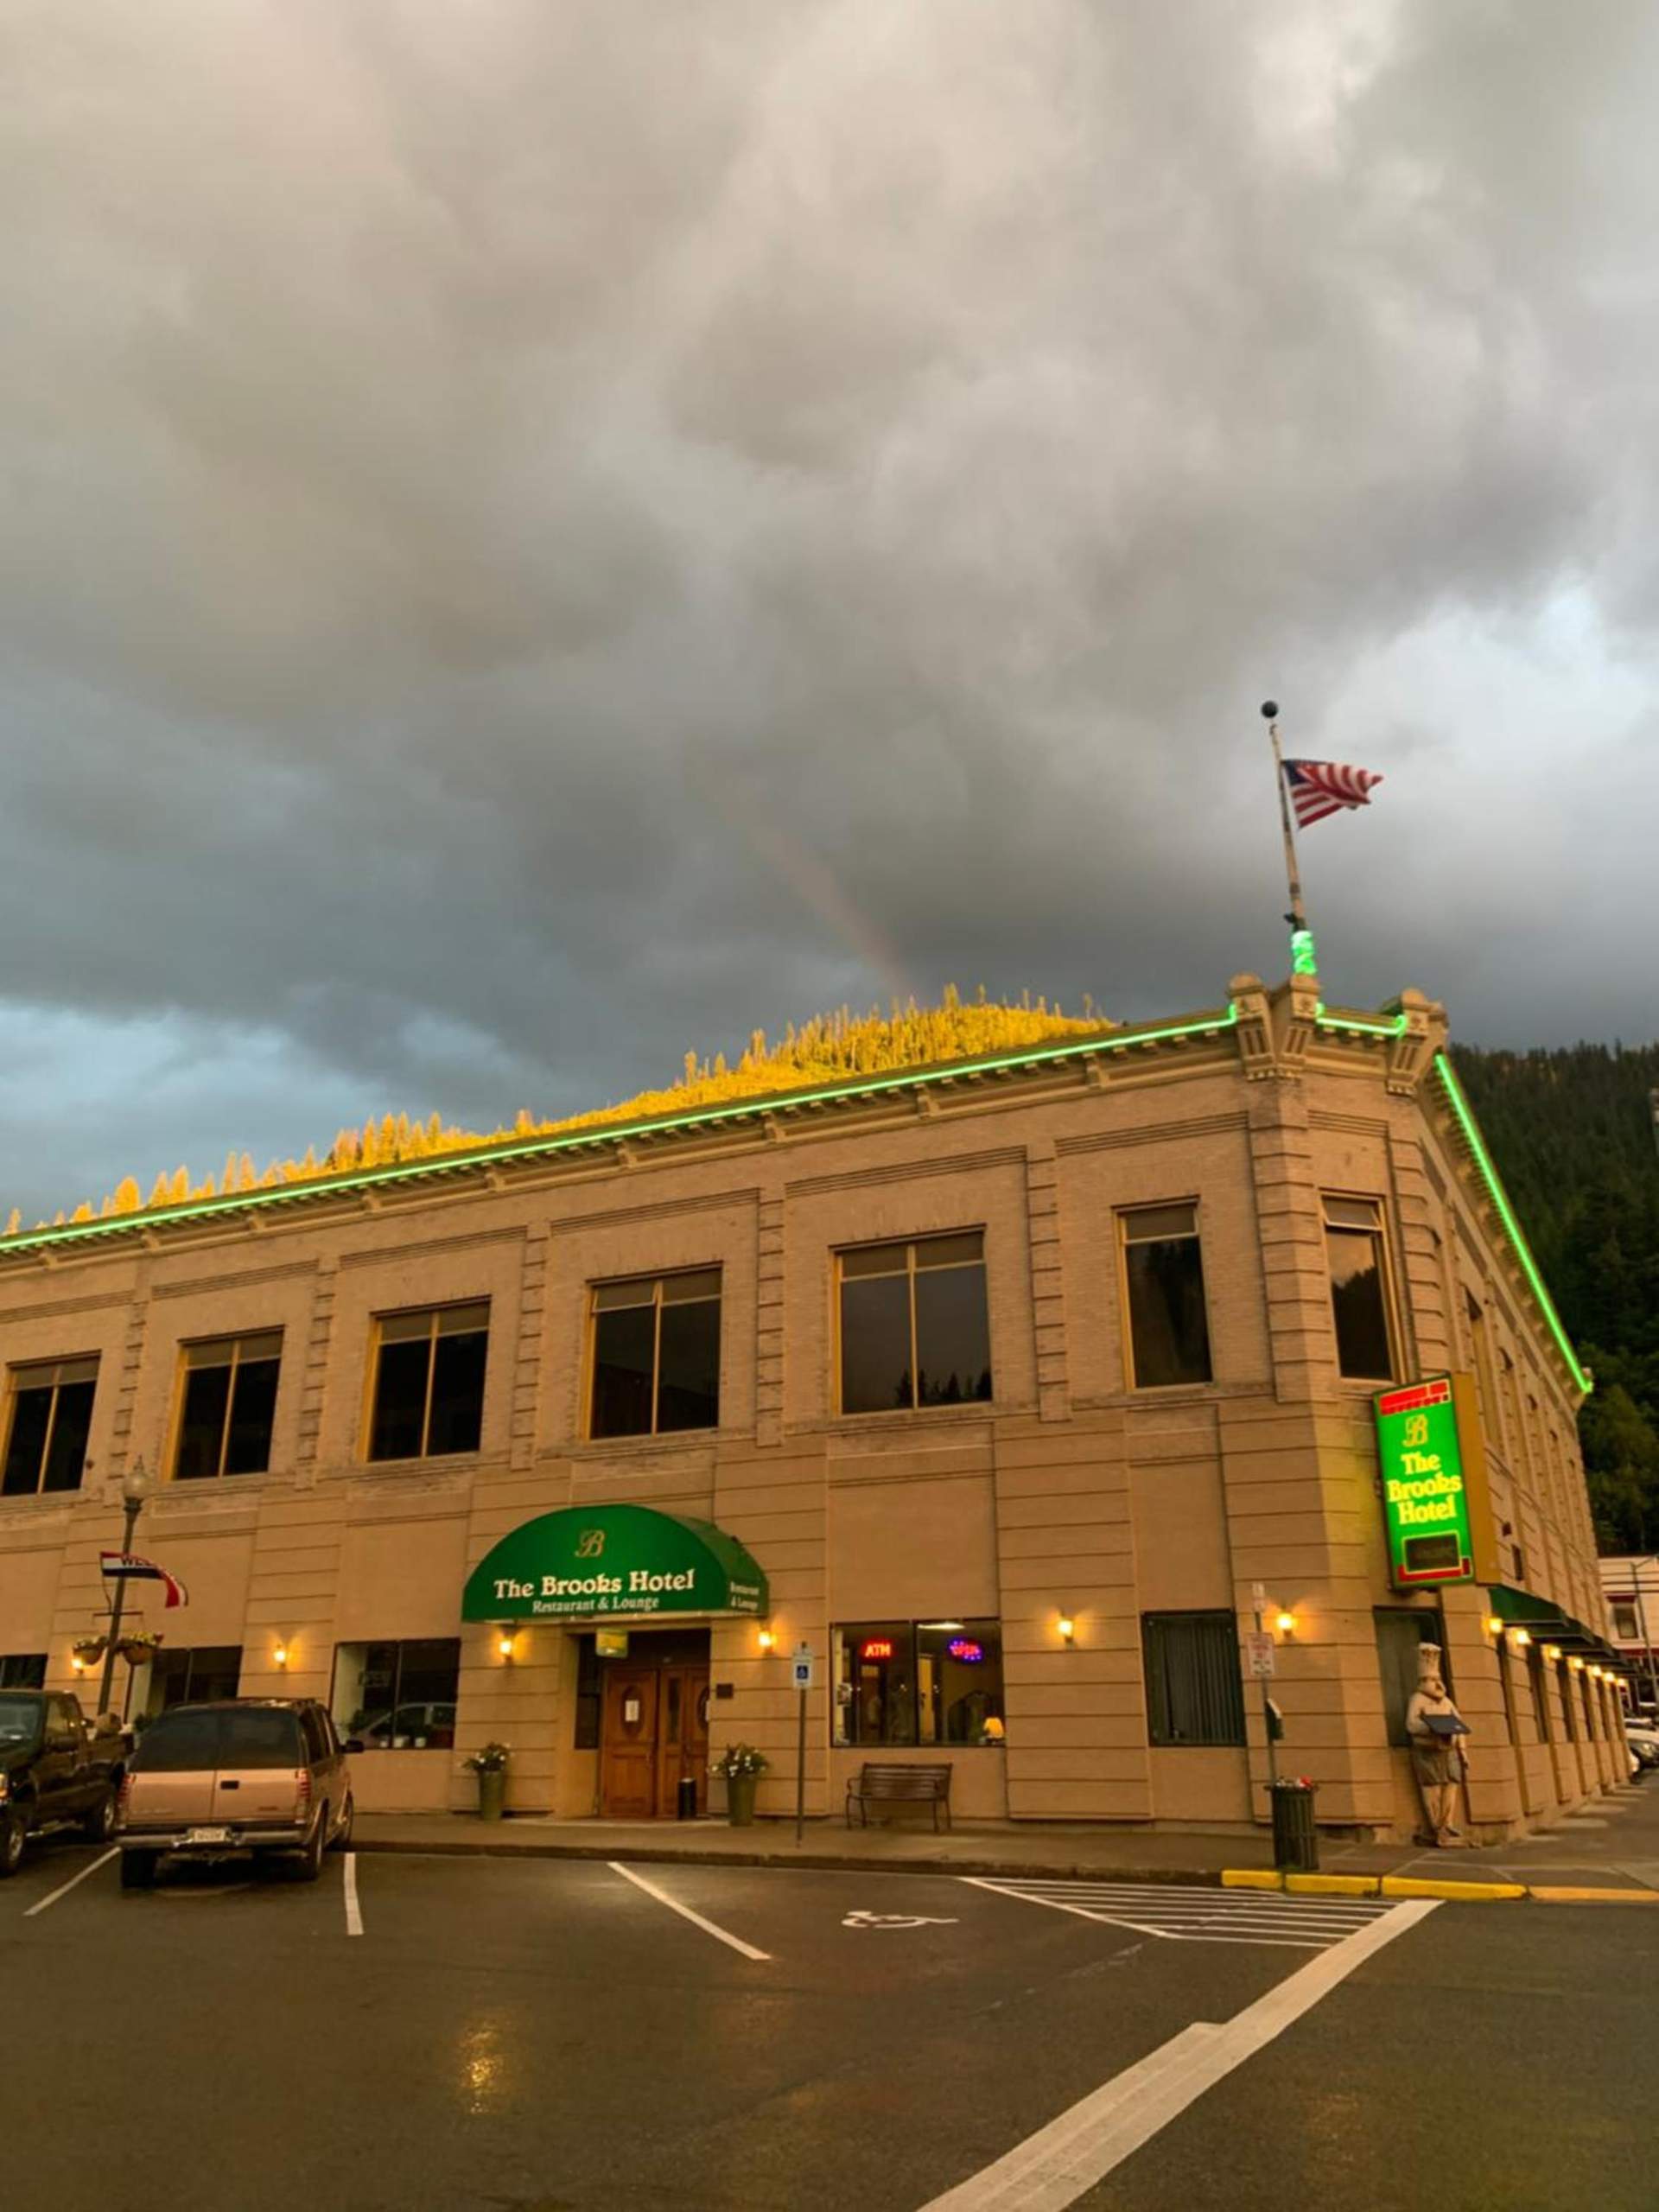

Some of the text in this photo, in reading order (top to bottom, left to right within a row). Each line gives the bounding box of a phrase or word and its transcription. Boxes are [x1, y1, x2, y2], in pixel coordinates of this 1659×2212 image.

[1401, 1452, 1441, 1474] The
[1387, 1472, 1463, 1503] Brooks
[1396, 1495, 1457, 1524] Hotel
[493, 1568, 695, 1599] The Brooks Hotel
[532, 1595, 660, 1613] Restaurant & Lounge
[865, 1643, 891, 1657] ATM
